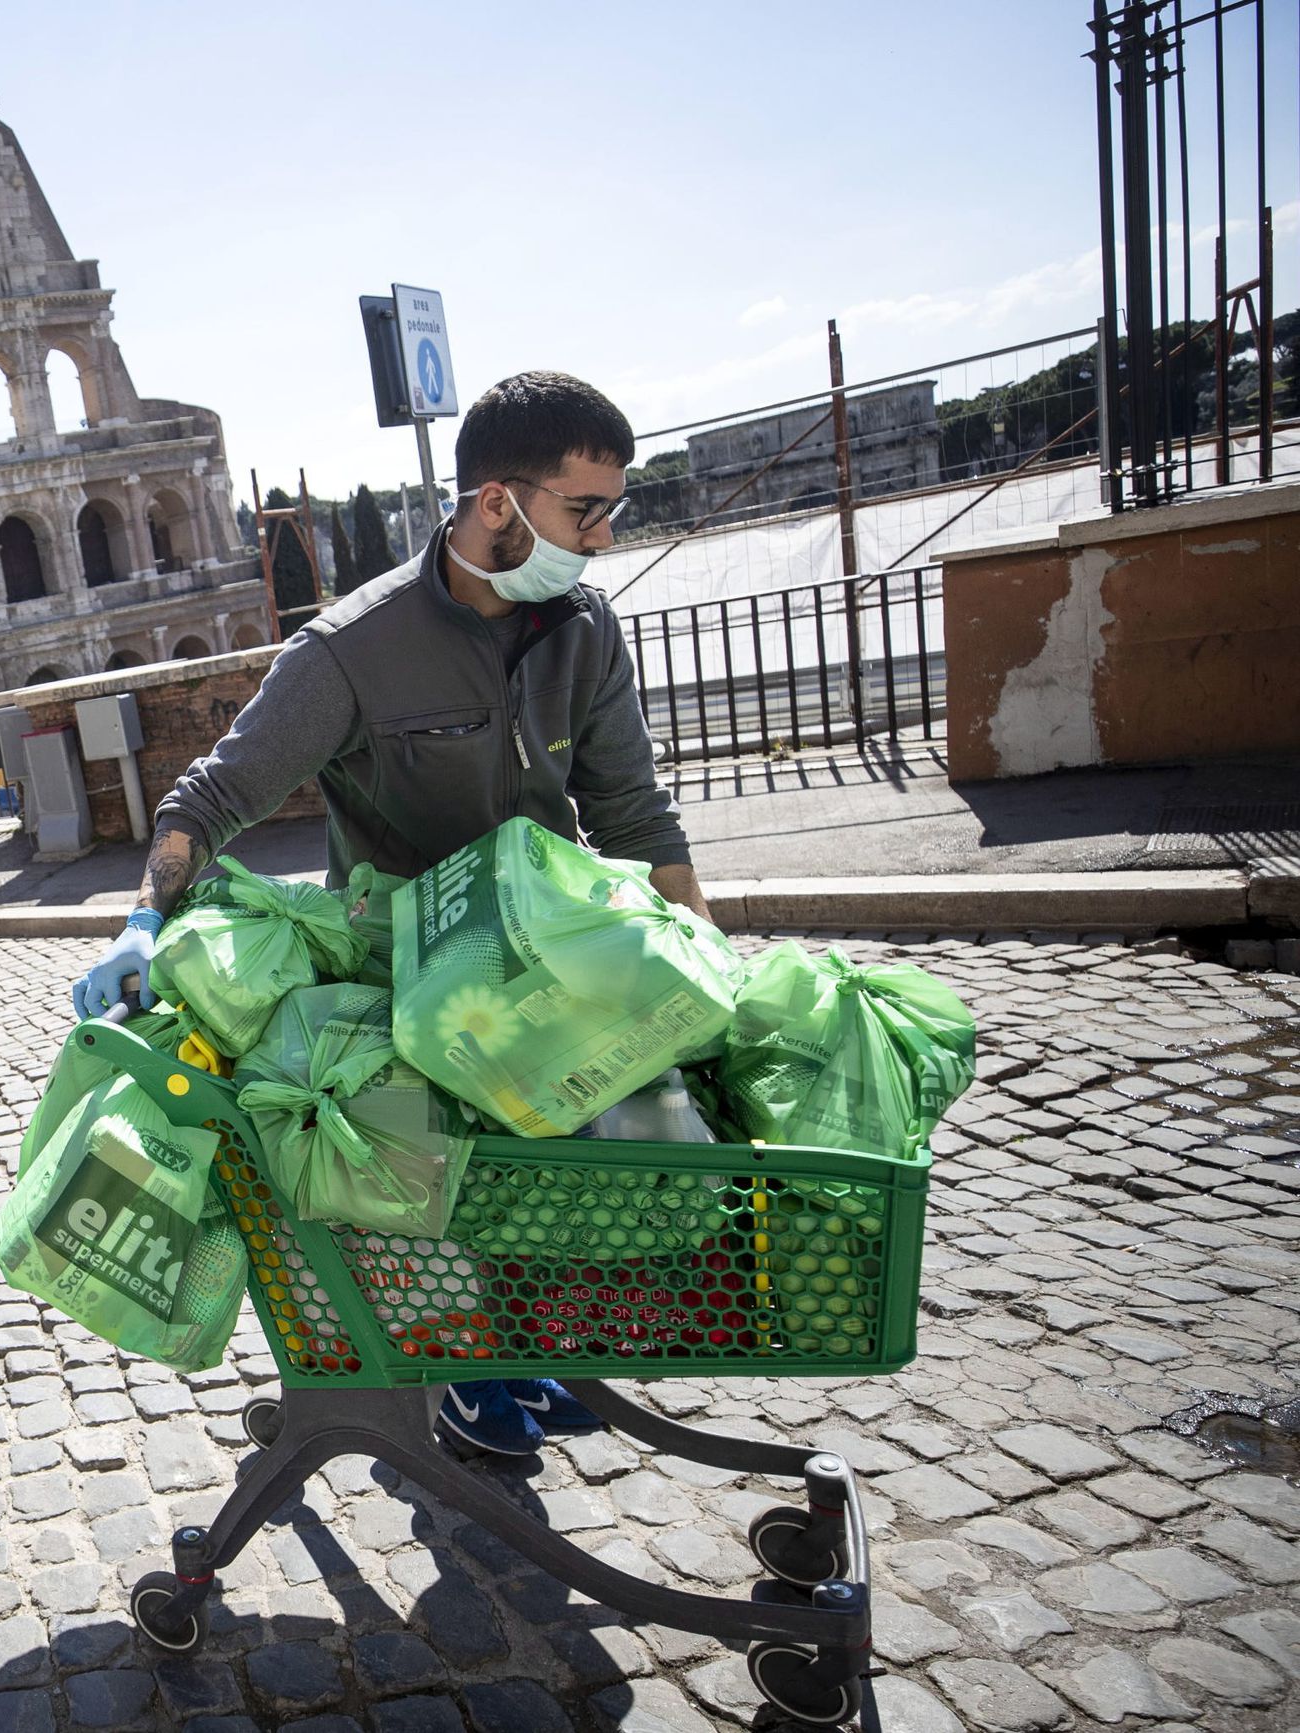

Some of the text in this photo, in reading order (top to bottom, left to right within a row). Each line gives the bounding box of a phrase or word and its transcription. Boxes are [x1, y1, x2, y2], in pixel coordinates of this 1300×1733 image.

[412, 299, 429, 312] area
[407, 317, 440, 334] pedonale
[571, 1288, 647, 1304] BOTIGLIE
[534, 1304, 594, 1318] QESA
